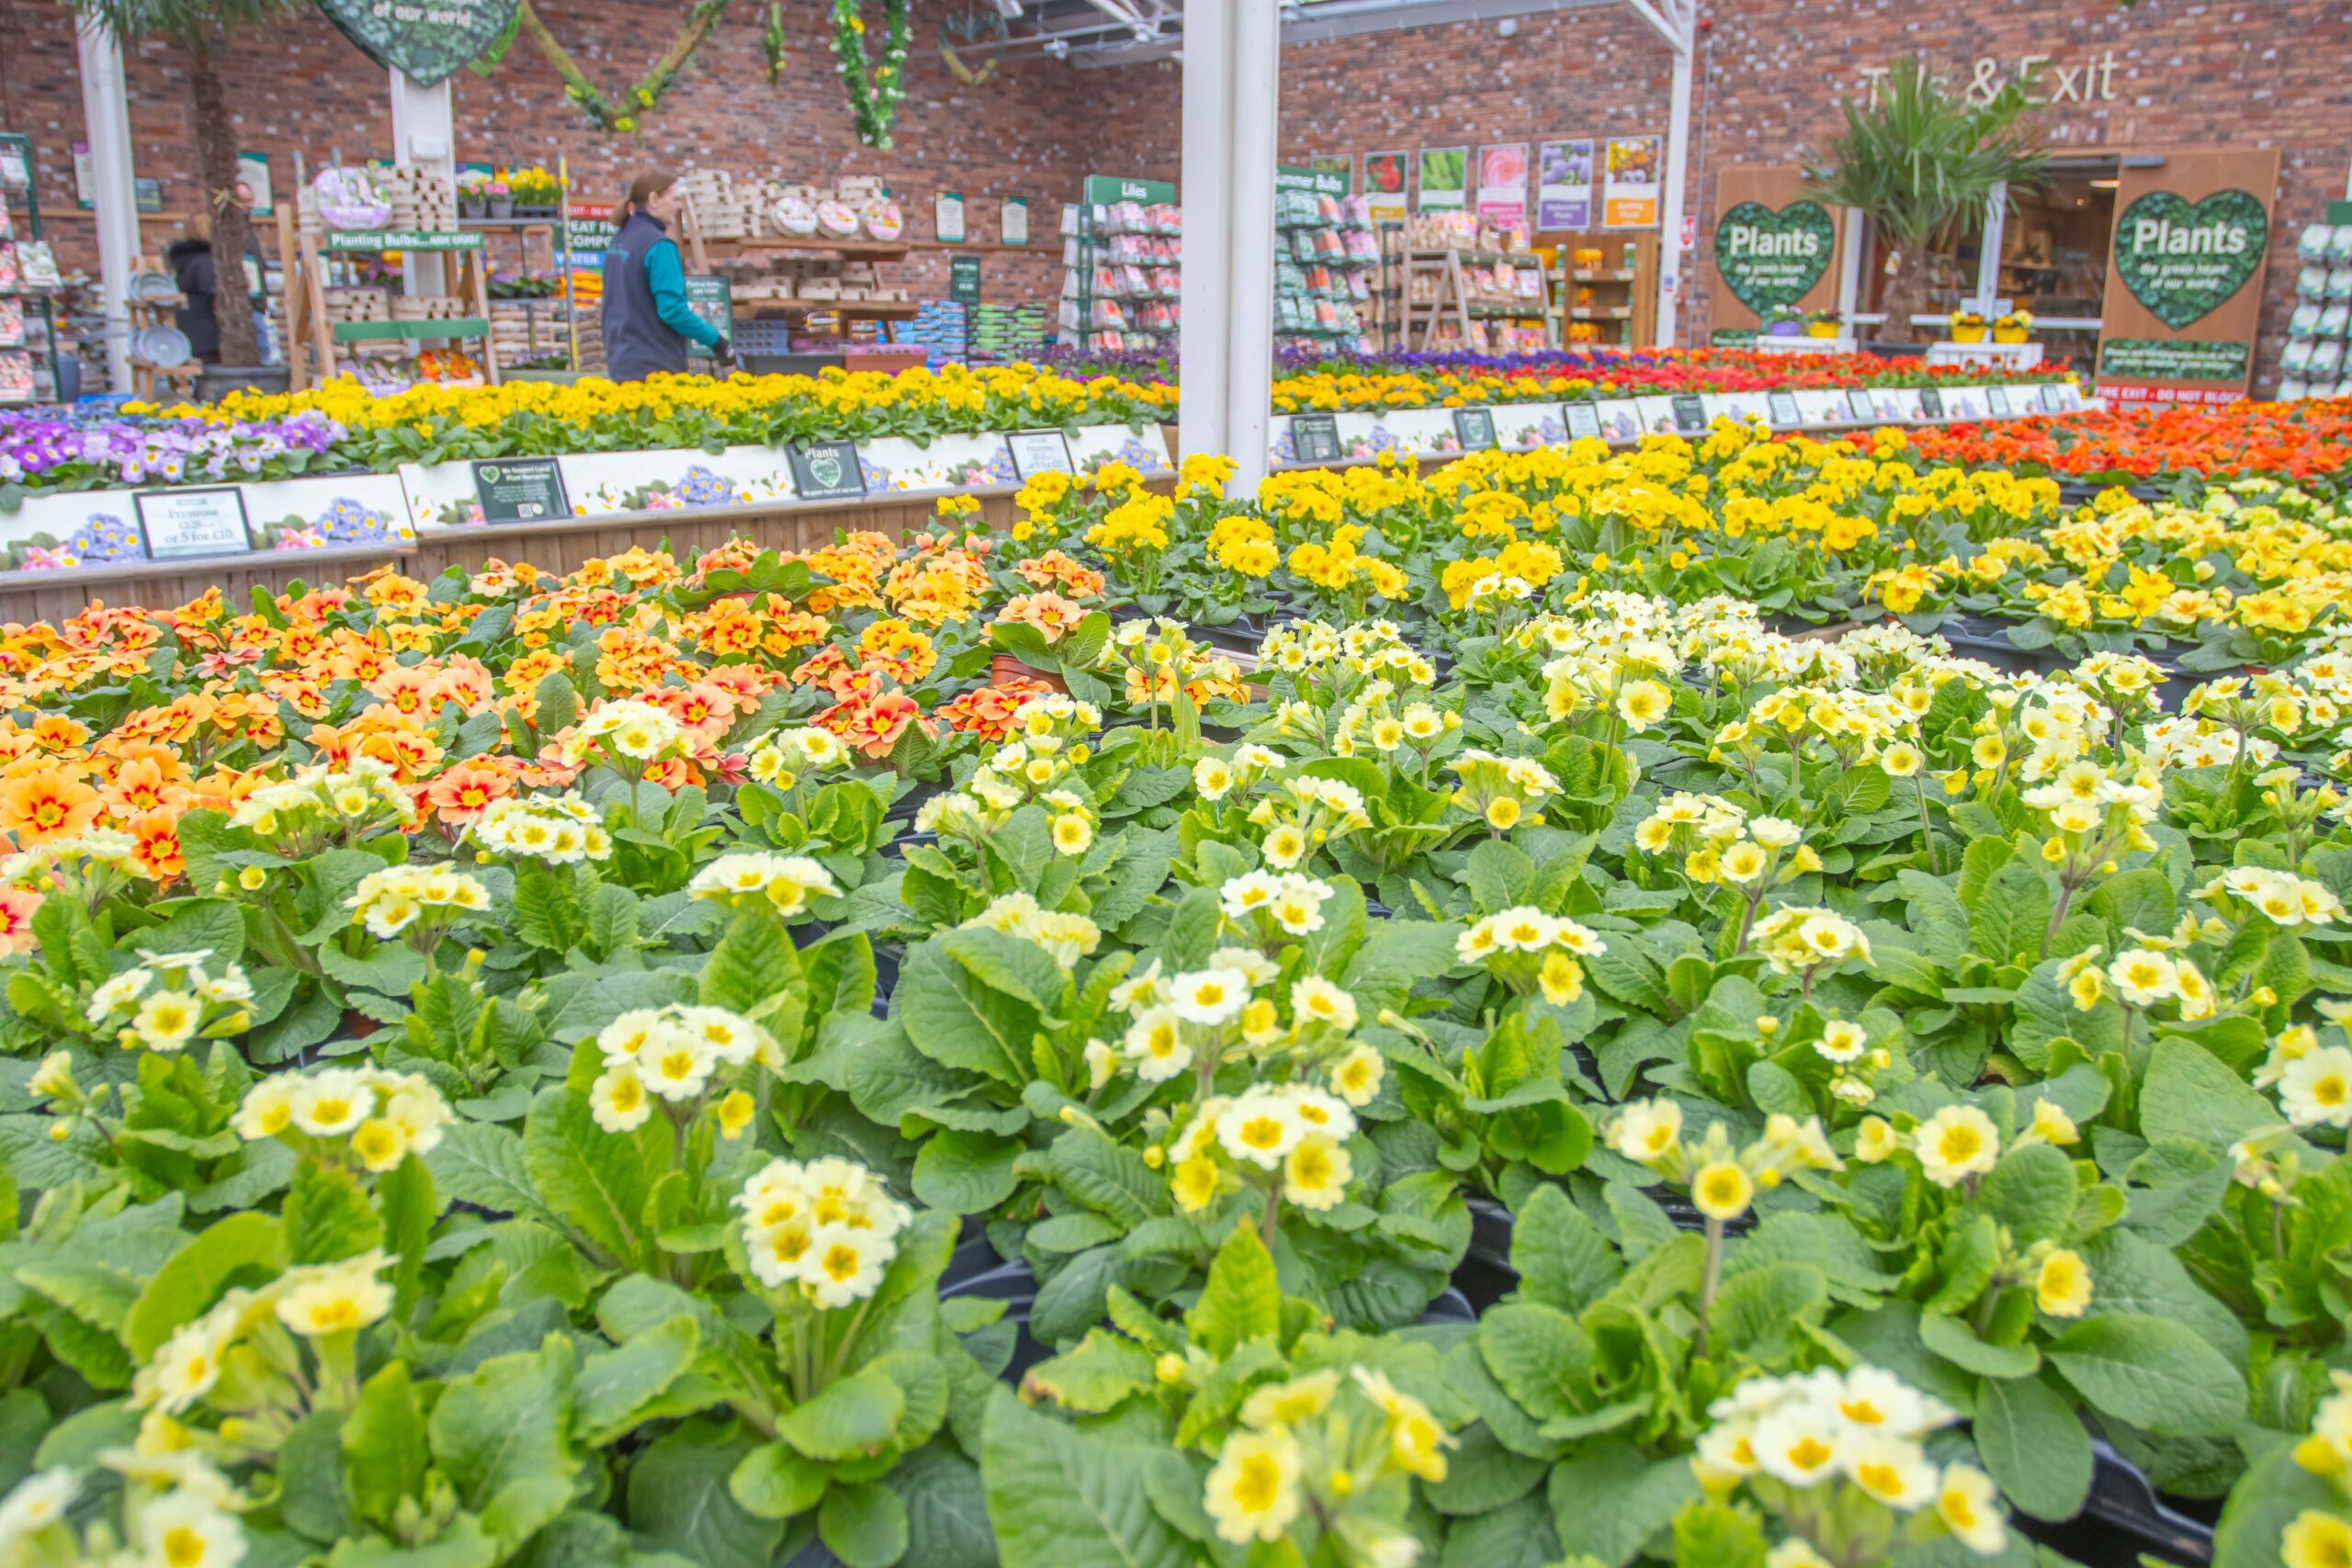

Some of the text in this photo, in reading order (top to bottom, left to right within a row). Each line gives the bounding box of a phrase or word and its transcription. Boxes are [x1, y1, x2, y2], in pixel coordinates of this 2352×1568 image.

[372, 2, 471, 28] of our world
[1965, 56, 2007, 106] &
[2020, 51, 2120, 104] Exit
[1275, 173, 1314, 188] ummer
[567, 220, 597, 234] EAT
[332, 233, 382, 249] Planting
[1729, 224, 1818, 256] Plants
[2133, 218, 2247, 255] Plants
[1736, 263, 1807, 275] the green heart
[2140, 263, 2229, 277] the green heart
[1745, 276, 1800, 286] of our world
[2150, 277, 2220, 290] of our world
[2095, 386, 2120, 399] FIRE
[2121, 387, 2149, 400] EXIT
[2157, 388, 2176, 400] DO
[2177, 389, 2201, 402] NOT
[168, 508, 219, 519] Primrose
[164, 536, 177, 544] or
[181, 532, 189, 542] 5
[191, 531, 209, 542] for
